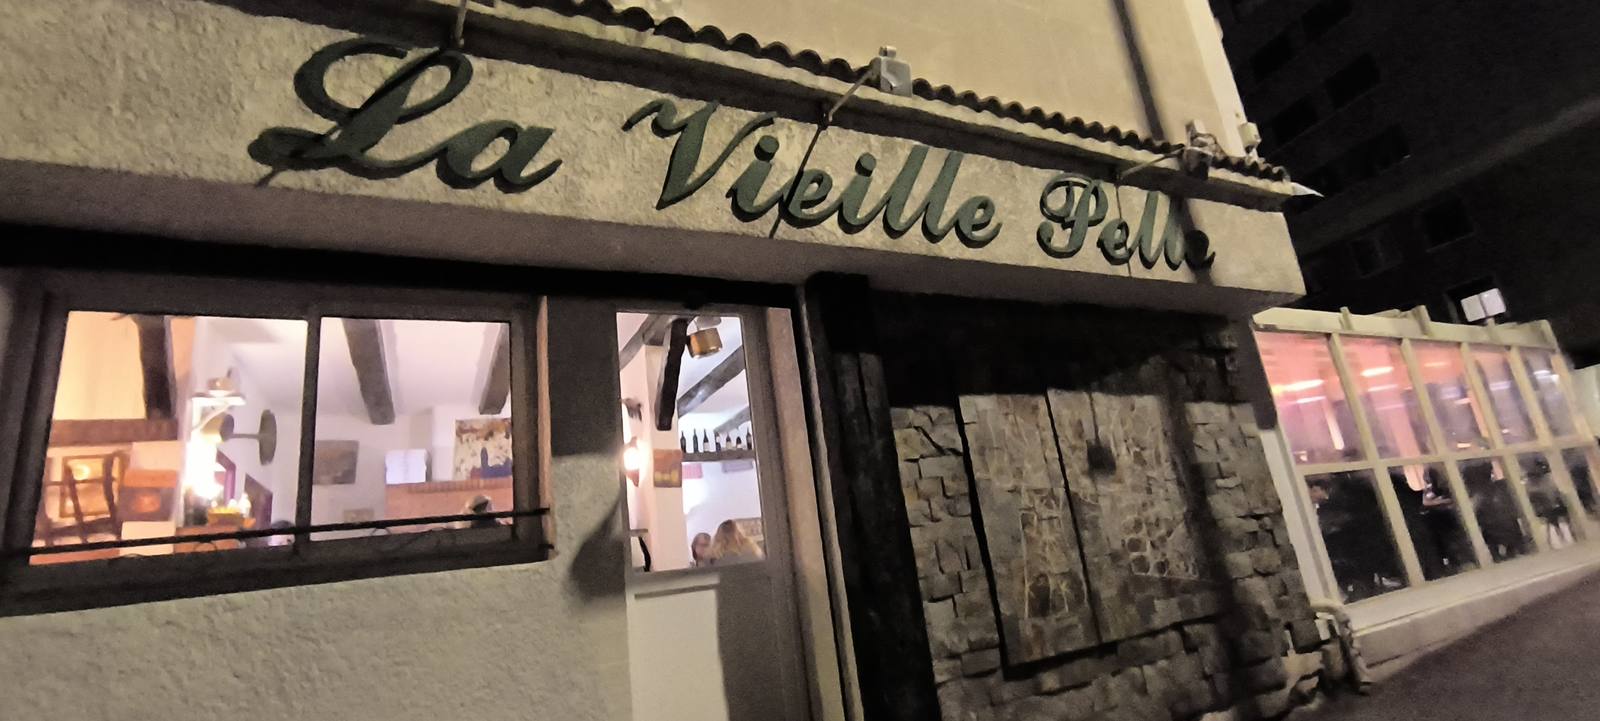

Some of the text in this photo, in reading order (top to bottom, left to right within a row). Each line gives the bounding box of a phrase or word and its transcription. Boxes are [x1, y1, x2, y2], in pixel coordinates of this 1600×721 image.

[248, 37, 1216, 271] La Vieille Pelle
